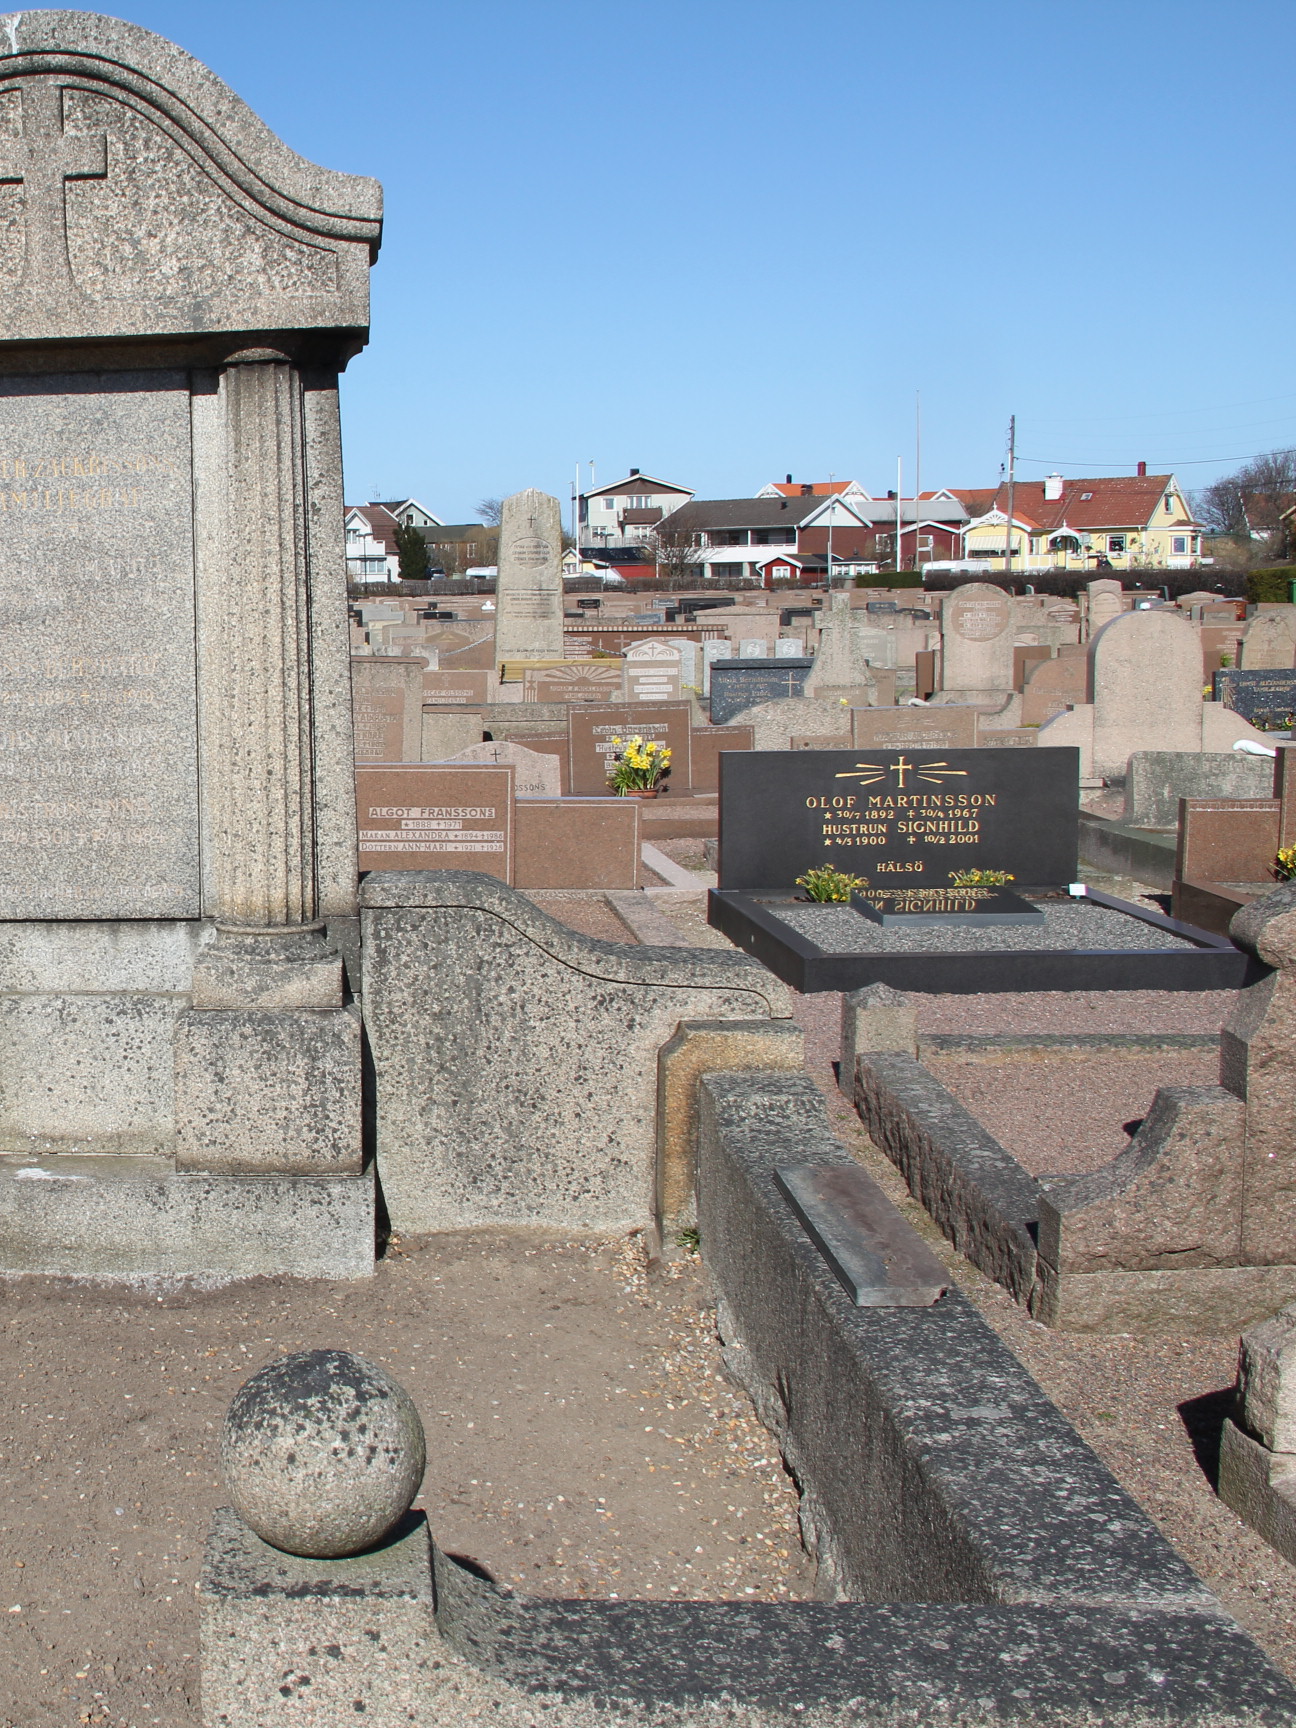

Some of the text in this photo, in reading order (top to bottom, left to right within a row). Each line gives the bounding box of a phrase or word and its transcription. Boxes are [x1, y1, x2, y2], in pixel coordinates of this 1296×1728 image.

[806, 794, 997, 809] OLOF MARTINSSON
[370, 808, 494, 818] ALGOT FRANSSONS
[836, 808, 979, 820] 30/7 1892 30/4 1967
[412, 821, 432, 829] 1888
[822, 820, 980, 835] HUSTRUN SIGNHILD
[393, 831, 450, 839] ALEXANDRA
[835, 834, 979, 846] 4/5 1900 10/2 2001
[876, 860, 924, 872] HÄLSÖ
